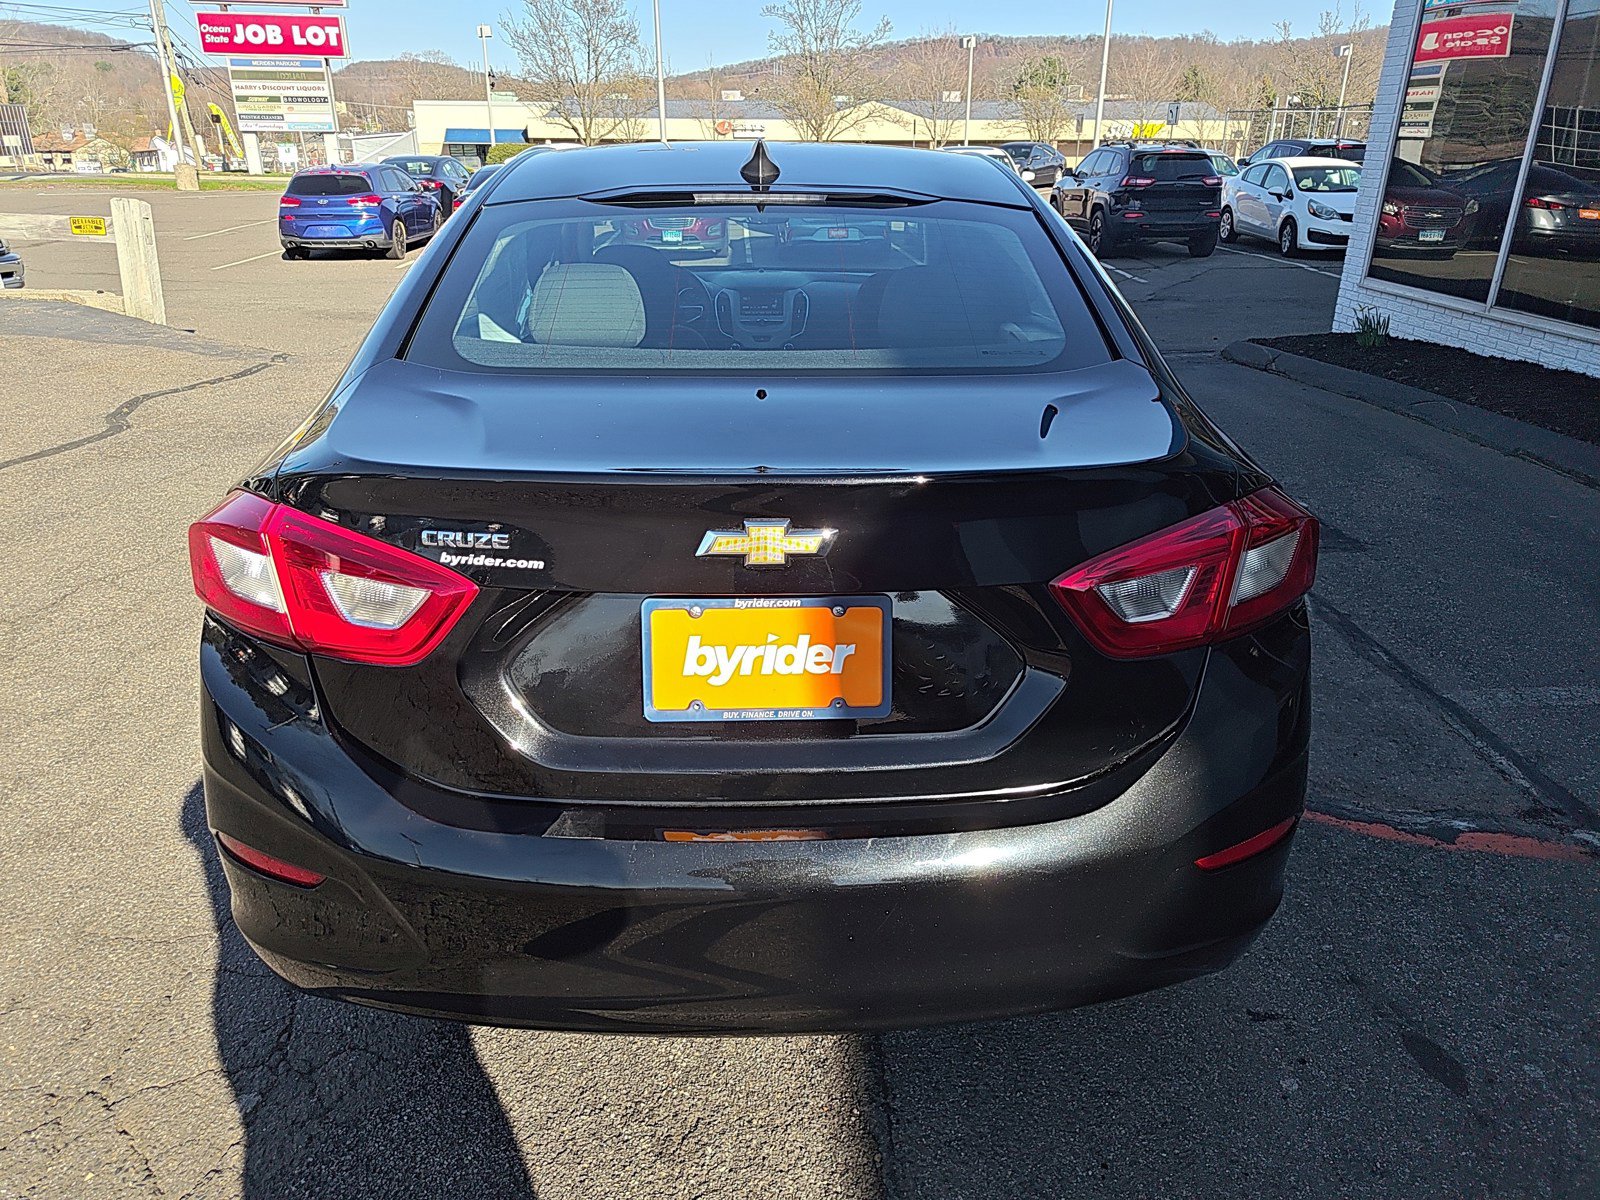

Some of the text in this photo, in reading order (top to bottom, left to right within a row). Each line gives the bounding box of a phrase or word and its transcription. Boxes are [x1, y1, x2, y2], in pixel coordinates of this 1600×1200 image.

[200, 23, 231, 34] Ocean
[204, 34, 230, 44] State
[233, 23, 340, 46] JOB LOT
[72, 218, 102, 226] RELIABLE
[421, 530, 510, 549] CRUZE
[440, 552, 545, 569] byrider.com
[734, 598, 801, 609] byrider.com
[682, 633, 857, 687] byrider
[741, 711, 776, 719] FINANCE.
[801, 710, 815, 718] ON.
